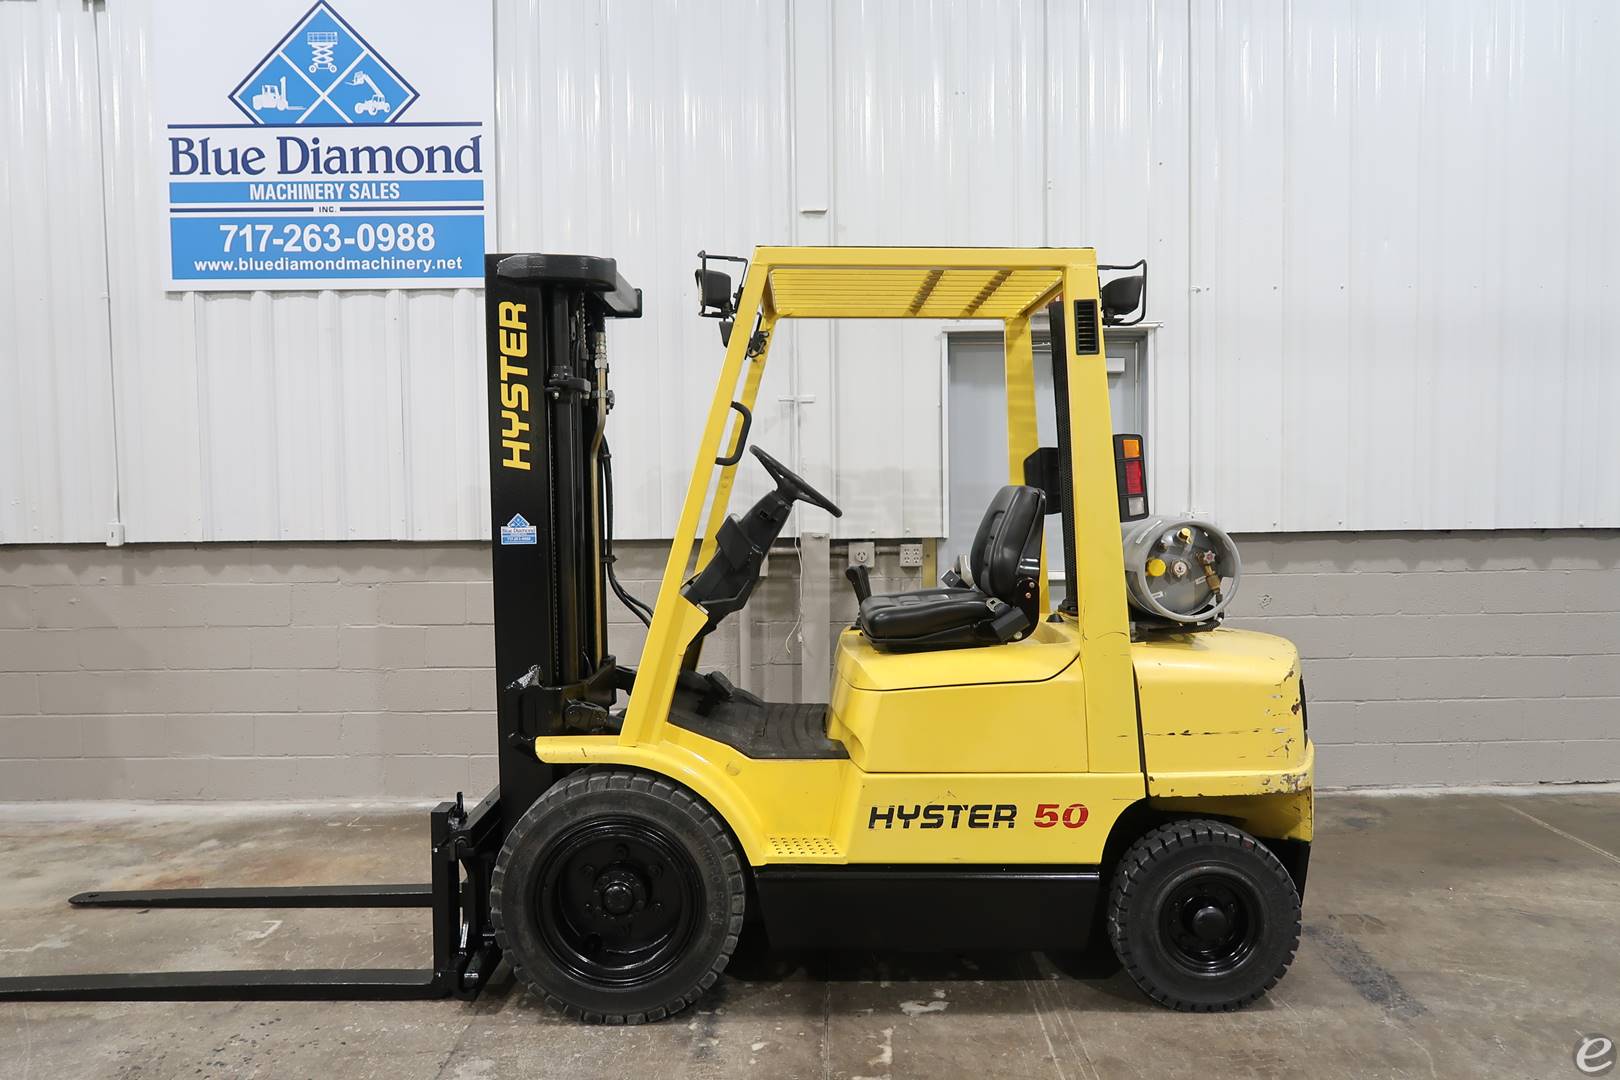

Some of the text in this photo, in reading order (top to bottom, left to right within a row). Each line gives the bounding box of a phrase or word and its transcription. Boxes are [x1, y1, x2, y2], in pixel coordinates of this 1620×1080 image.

[168, 134, 483, 176] Blue Diamond
[249, 182, 400, 201] MACHINERY SALES
[318, 205, 338, 213] INC.
[219, 223, 436, 253] 717-263-0988
[194, 256, 463, 273] www.bluediamondmachinery.net
[498, 301, 531, 471] HYSTER
[868, 803, 1089, 829] HYSTER 50
